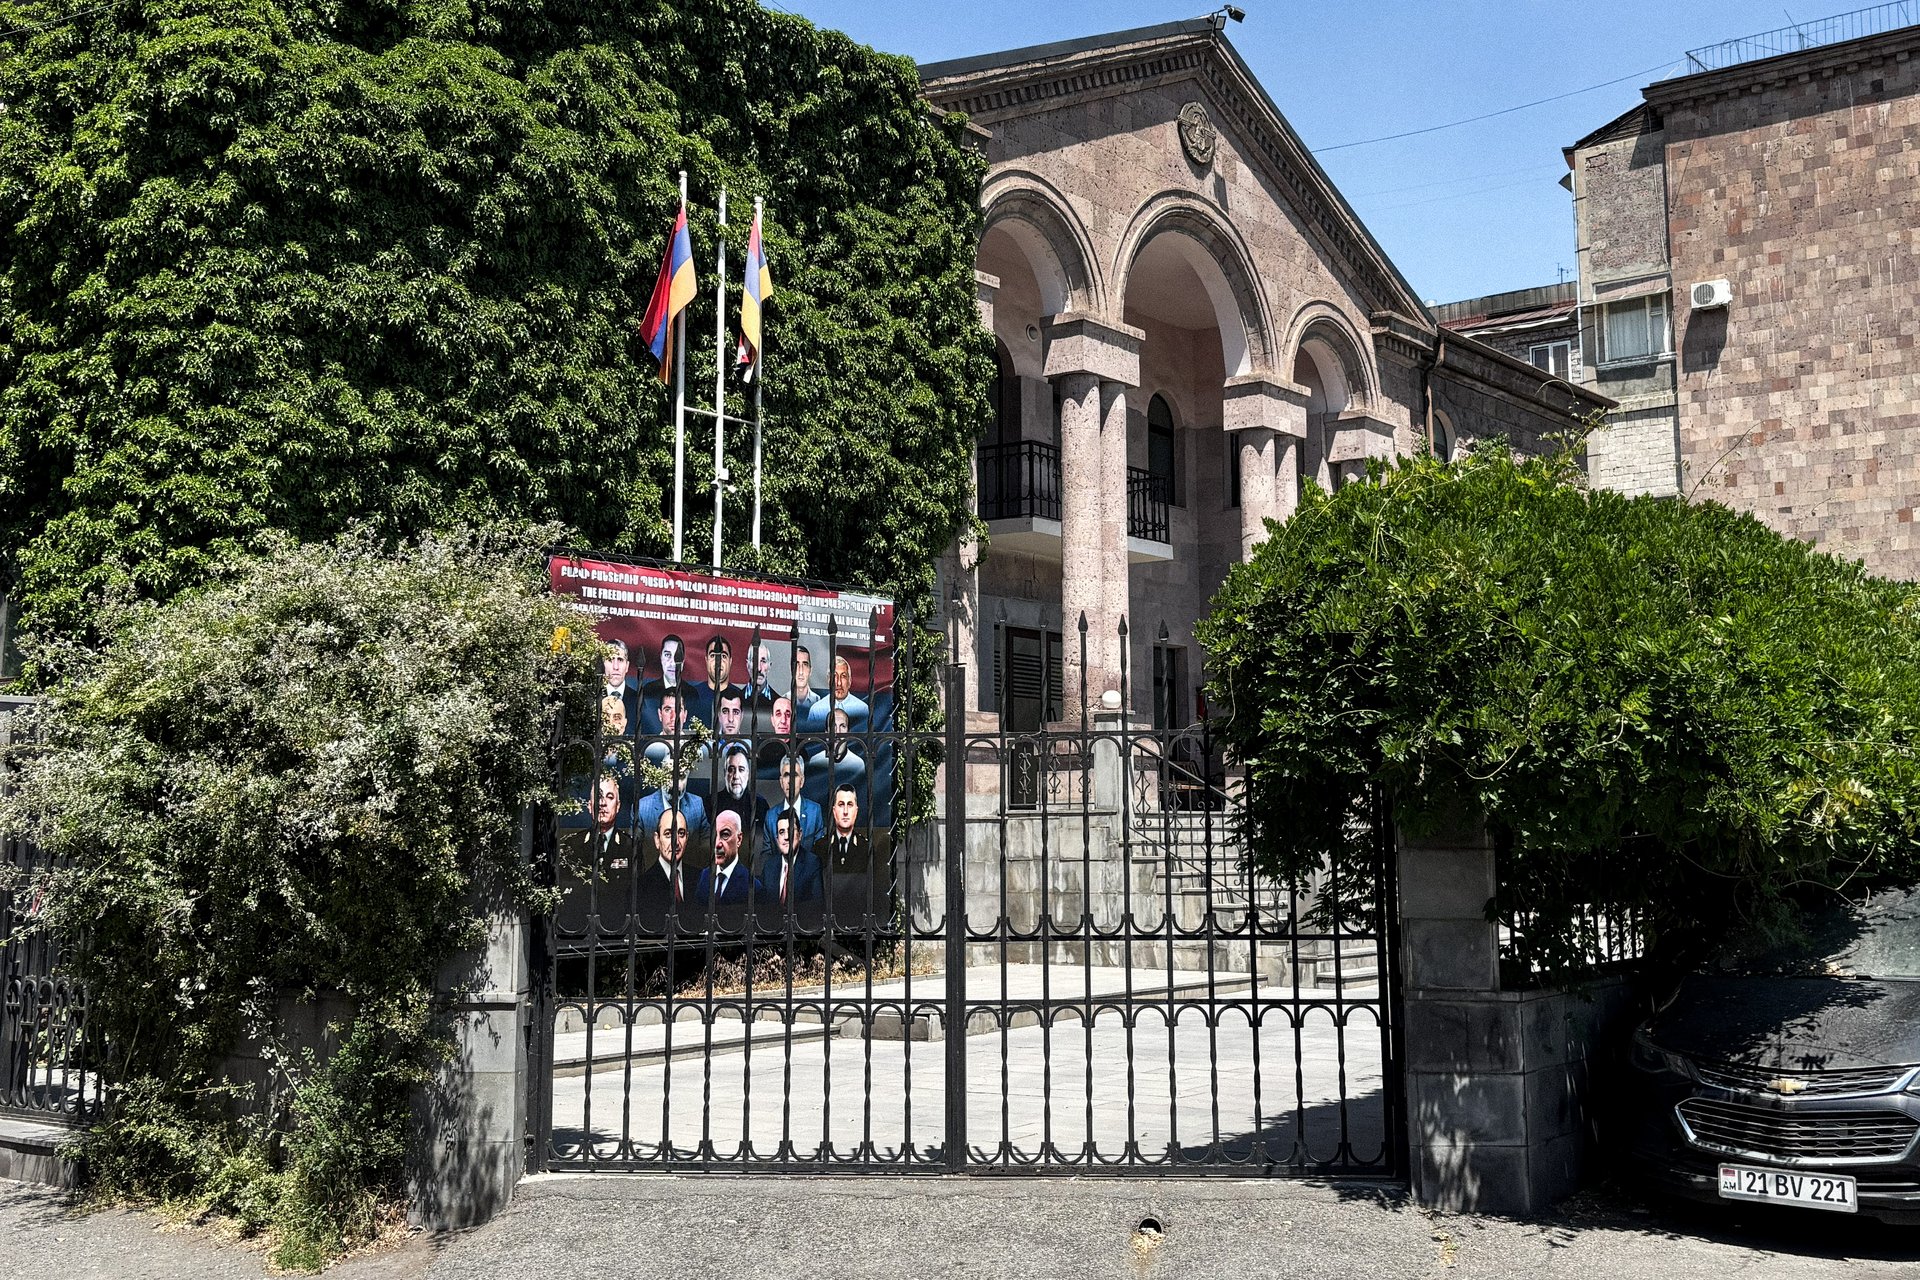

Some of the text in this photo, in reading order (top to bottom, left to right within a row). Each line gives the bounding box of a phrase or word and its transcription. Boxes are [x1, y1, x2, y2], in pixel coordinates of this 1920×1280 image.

[582, 586, 597, 598] THE
[598, 588, 634, 602] FREEDOM
[635, 592, 645, 603] OF
[645, 593, 689, 608] ARMENIANS
[690, 598, 708, 611] HELD
[708, 600, 740, 614] HOSTAGE
[740, 603, 748, 615] IN
[775, 608, 804, 621] PRISONS
[804, 612, 812, 622] IS
[812, 612, 816, 622] A
[816, 613, 845, 625] NATINAL
[1722, 1181, 1736, 1191] AM
[1746, 1171, 1848, 1203] 21 BV 221
